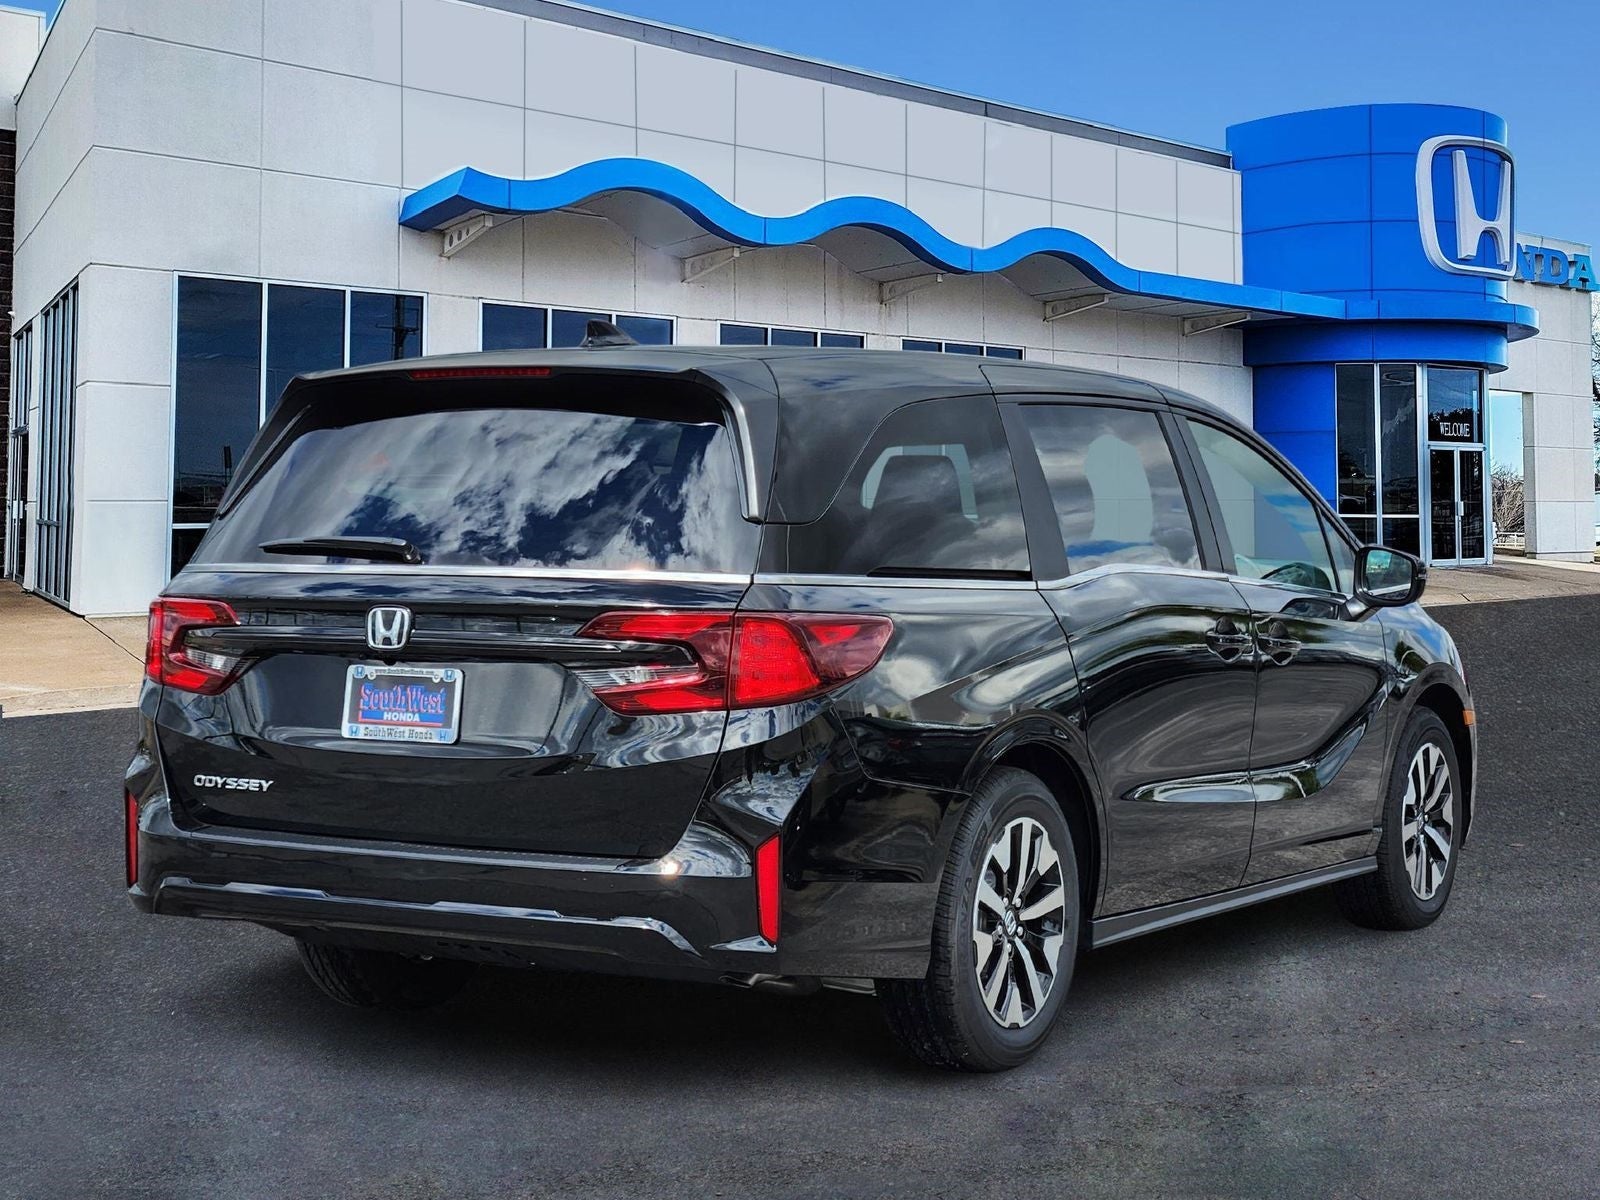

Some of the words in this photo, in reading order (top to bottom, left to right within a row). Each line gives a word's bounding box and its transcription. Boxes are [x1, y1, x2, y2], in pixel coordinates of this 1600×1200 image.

[1514, 242, 1600, 291] NDA
[1439, 421, 1471, 437] WELCOME
[359, 682, 447, 714] SouthWest
[383, 711, 421, 722] HONDA
[363, 727, 406, 738] SouthWest
[407, 729, 433, 740] Honda
[193, 774, 274, 792] ODYSSEY
